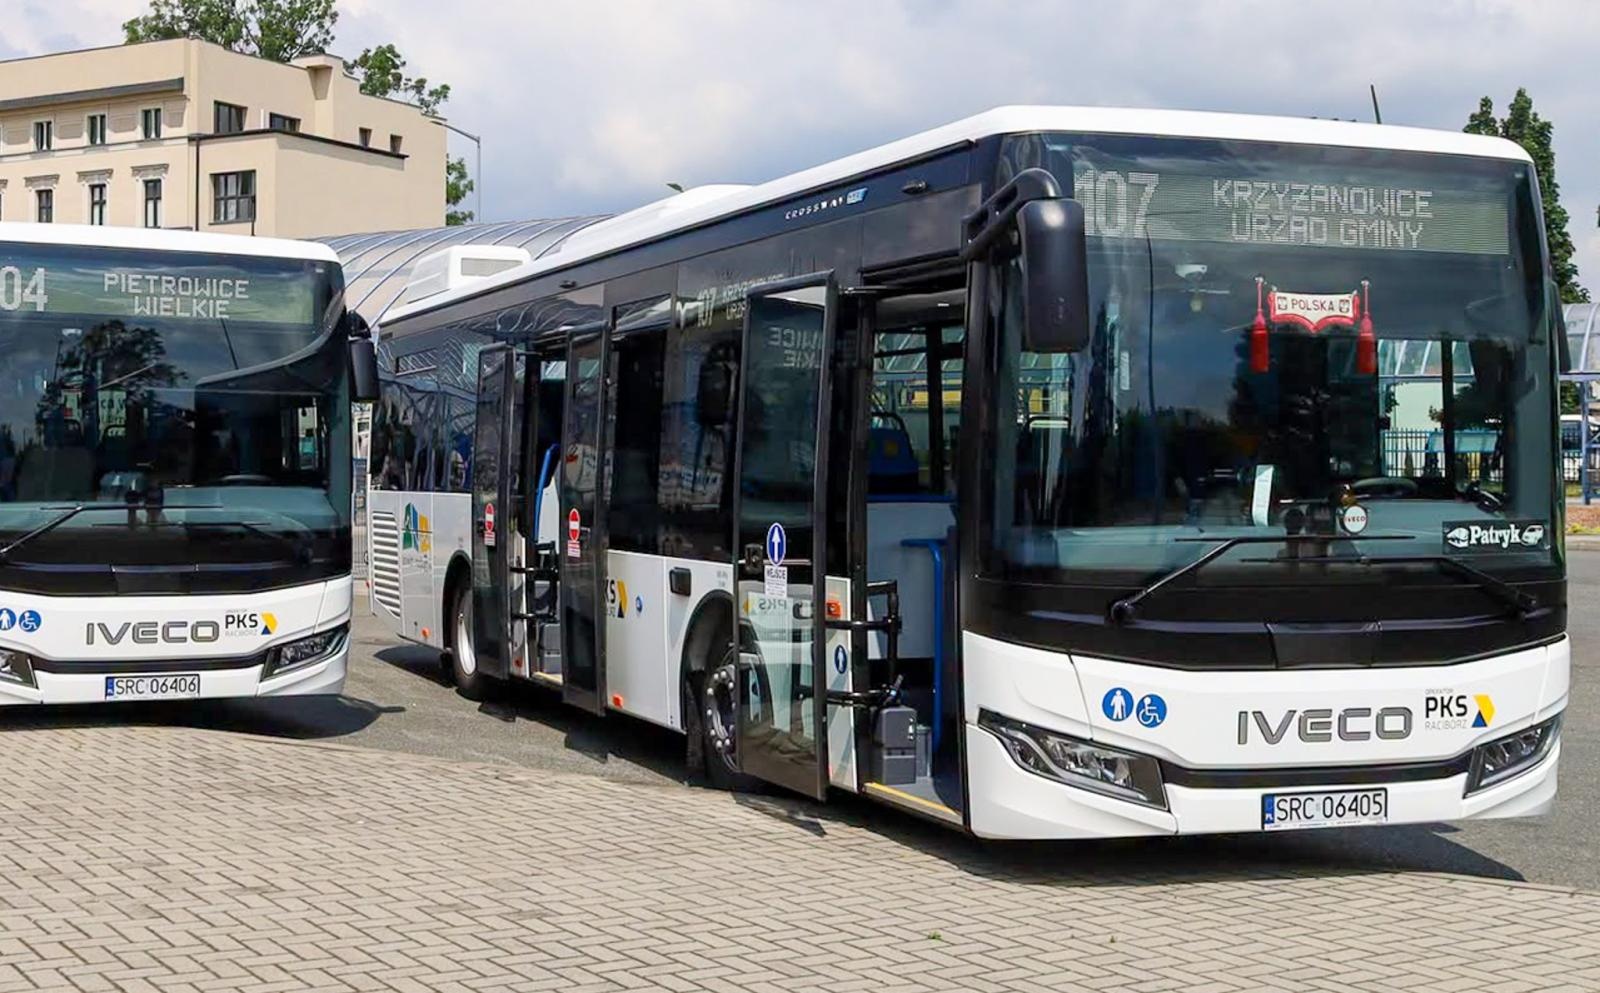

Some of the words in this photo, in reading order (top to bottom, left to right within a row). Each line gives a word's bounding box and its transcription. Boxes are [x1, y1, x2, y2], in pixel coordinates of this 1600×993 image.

[1074, 169, 1159, 239] 107
[1340, 218, 1423, 249] GMINY
[104, 272, 250, 299] PIETROWICE
[133, 296, 230, 319] WIELKIE
[1291, 298, 1335, 311] POLSKA
[1469, 524, 1522, 549] Patryk
[86, 620, 219, 646] IVECO
[225, 613, 258, 629] PKS
[115, 679, 145, 695] SRC
[150, 677, 196, 694] 06406
[1425, 695, 1468, 719] PKS
[1237, 706, 1413, 746] IVECO
[1276, 796, 1315, 821] SRC
[1322, 792, 1383, 819] 06405
